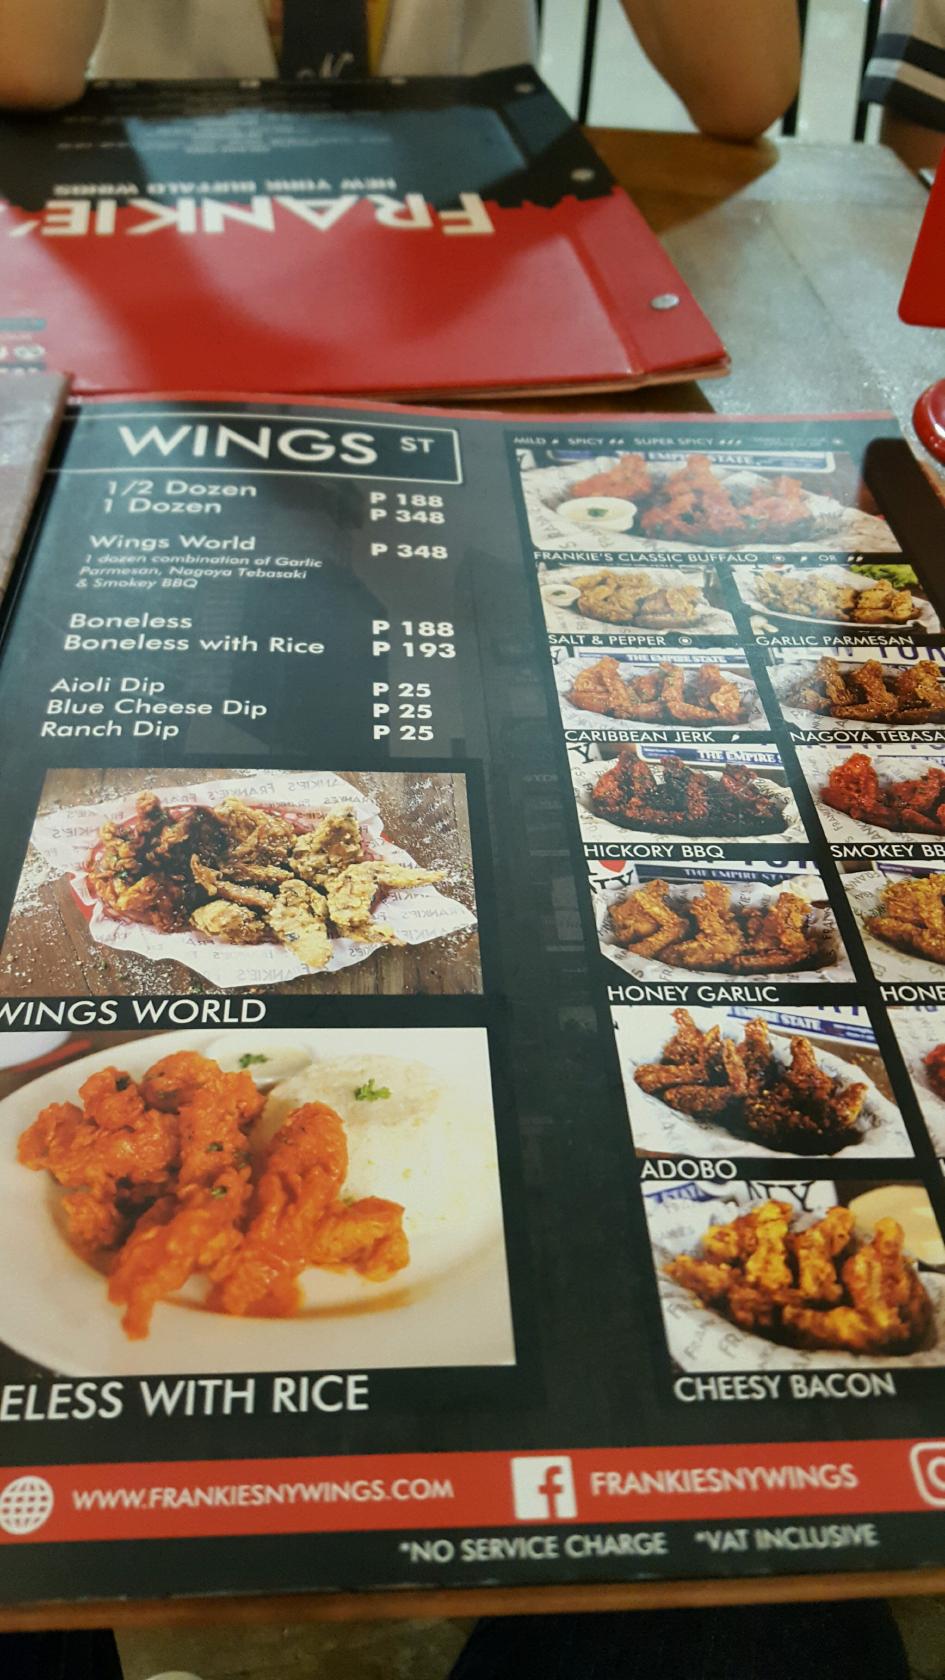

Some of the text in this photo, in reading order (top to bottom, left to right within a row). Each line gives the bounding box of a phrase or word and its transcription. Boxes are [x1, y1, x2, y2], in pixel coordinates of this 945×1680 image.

[8, 192, 495, 237] FRANKIE'
[118, 424, 435, 466] WINGS ST
[513, 437, 714, 447] MILD SPICY SUPER SPICY
[108, 480, 258, 497] 1/2 Dozen
[103, 497, 222, 514] 1 Dozen
[369, 491, 444, 508] P 188
[369, 508, 445, 524] P 348
[89, 535, 257, 551] Wings World
[370, 542, 449, 559] P 348
[97, 554, 147, 564] dozen
[151, 554, 250, 566] combination
[253, 556, 272, 567] of
[275, 557, 324, 568] Garlic
[532, 551, 759, 563] FRANKIE'S CLASSIC BUFFALO
[818, 554, 837, 562] OR
[79, 566, 307, 579] Parmesan, Nagoya Tebasaki
[75, 578, 199, 590] & Smokey BBQ
[69, 612, 193, 629] Boneless
[372, 620, 455, 637] P 188
[63, 633, 326, 654] Boneless with Rice
[547, 634, 667, 646] SALT & PEPPER
[756, 635, 915, 647] GARLIC PARMESAN
[372, 641, 457, 658] P 193
[50, 676, 166, 696] Aioli Dip
[372, 682, 432, 698] P 25
[45, 698, 268, 720] Blue Cheese Dip
[372, 703, 433, 719] P 25
[40, 720, 180, 741] Ranch Dip
[373, 724, 435, 741] P 25
[564, 730, 717, 743] CARIBBEAN JERK
[789, 731, 945, 743] NAGOYA TEBASA
[697, 750, 776, 763] THE EMPIRE
[583, 844, 726, 859] HICKORY BBQ
[830, 844, 914, 858] SMOKEY
[607, 985, 780, 1003] HONEY GARLIC
[879, 985, 945, 1002] HONE
[0, 998, 267, 1026] WINGS WORLD
[640, 1159, 738, 1180] ADOBO
[673, 1371, 897, 1402] CHEESY BACON
[0, 1374, 370, 1421] ELESS WITH RICE
[590, 1463, 860, 1497] FRANKIESNYWINGS
[72, 1478, 455, 1511] WWW.FRANKIESNYWINGS.COM
[755, 1522, 881, 1552] INCLUSIVE
[460, 1534, 560, 1562] SERVICE
[564, 1531, 669, 1559] CHARGE
